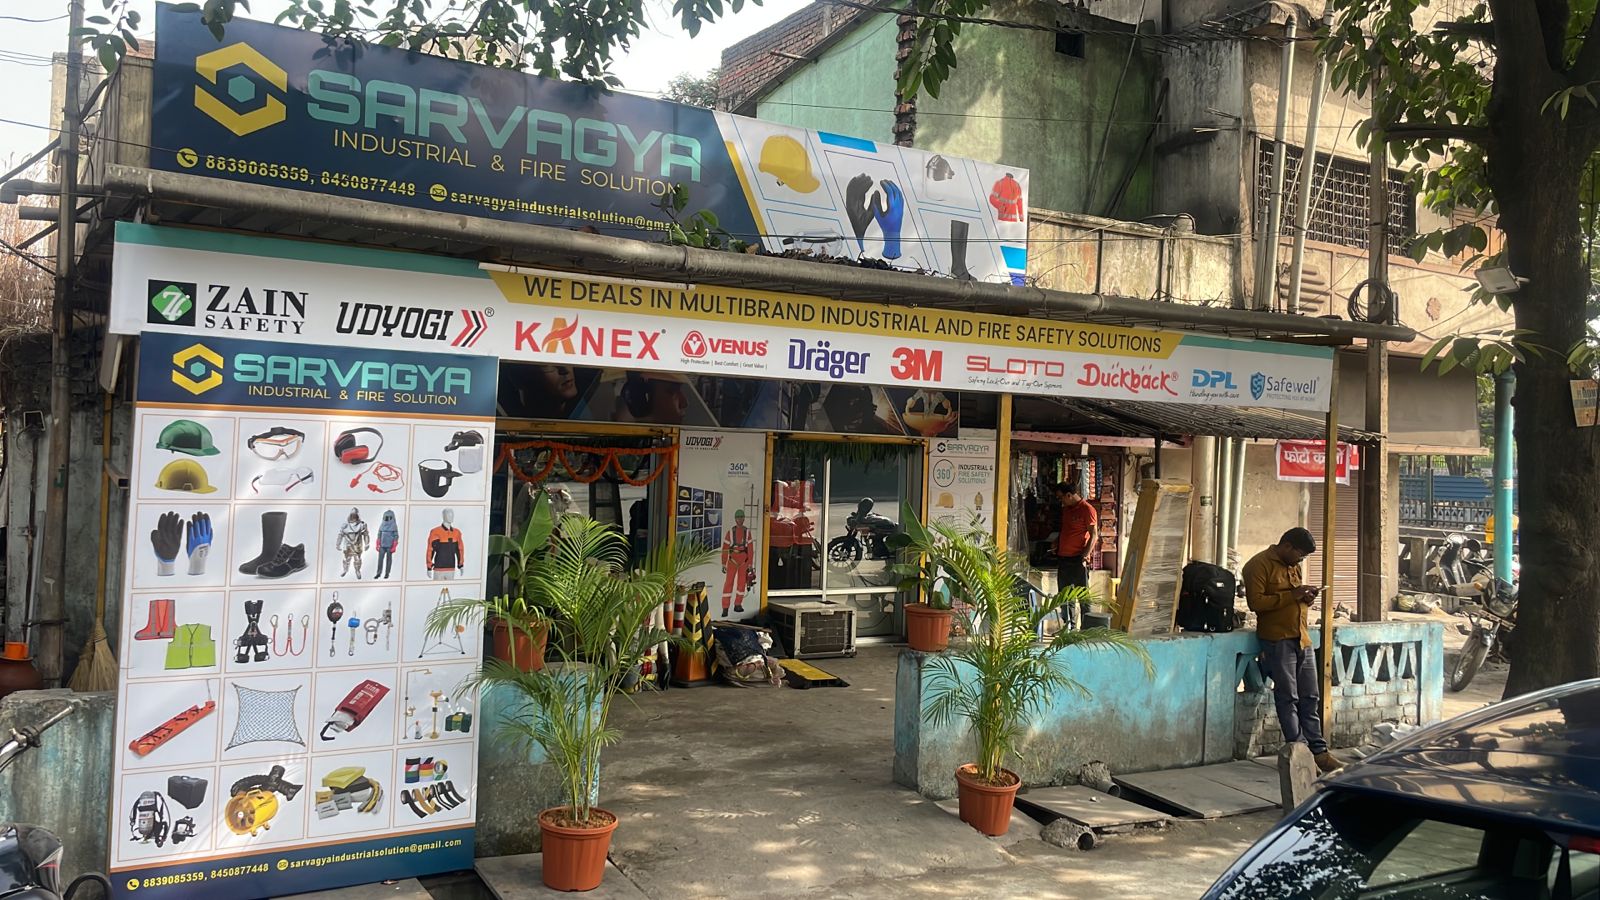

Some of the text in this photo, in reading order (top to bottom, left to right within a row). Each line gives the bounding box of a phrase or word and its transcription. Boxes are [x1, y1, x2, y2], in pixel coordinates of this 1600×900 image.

[307, 69, 701, 182] SARVAGYA
[334, 129, 476, 168] INDUSTRIAL
[490, 155, 505, 172] &
[520, 159, 567, 182] FIRE
[321, 171, 415, 196] 8450877448
[206, 284, 309, 319] ZAIN
[523, 275, 1161, 353] WE DEALS IN MULTIBRAND INDUSTRIAL AND FIRE SAFETY SOLUTIONS
[205, 314, 305, 335] SAFETY
[336, 301, 454, 341] UDYOGI
[514, 314, 661, 361] KANEX
[708, 338, 767, 356] VENUS
[788, 338, 870, 379] Dräger
[891, 347, 943, 382] 3M
[966, 355, 1064, 377] SLOTO
[233, 353, 471, 394] SARVAGYA
[1191, 368, 1238, 390] DPL
[1266, 376, 1317, 394] Safewell
[248, 385, 457, 405] INDUSTRIAL & FIRE SOLUTION
[686, 436, 713, 447] UDYOGI
[947, 443, 989, 452] SARVAGYA
[1284, 446, 1310, 464] फोटो
[290, 838, 462, 869] sarvagyaindustrialsolution@gmail.com
[210, 863, 269, 879] 8450877448
